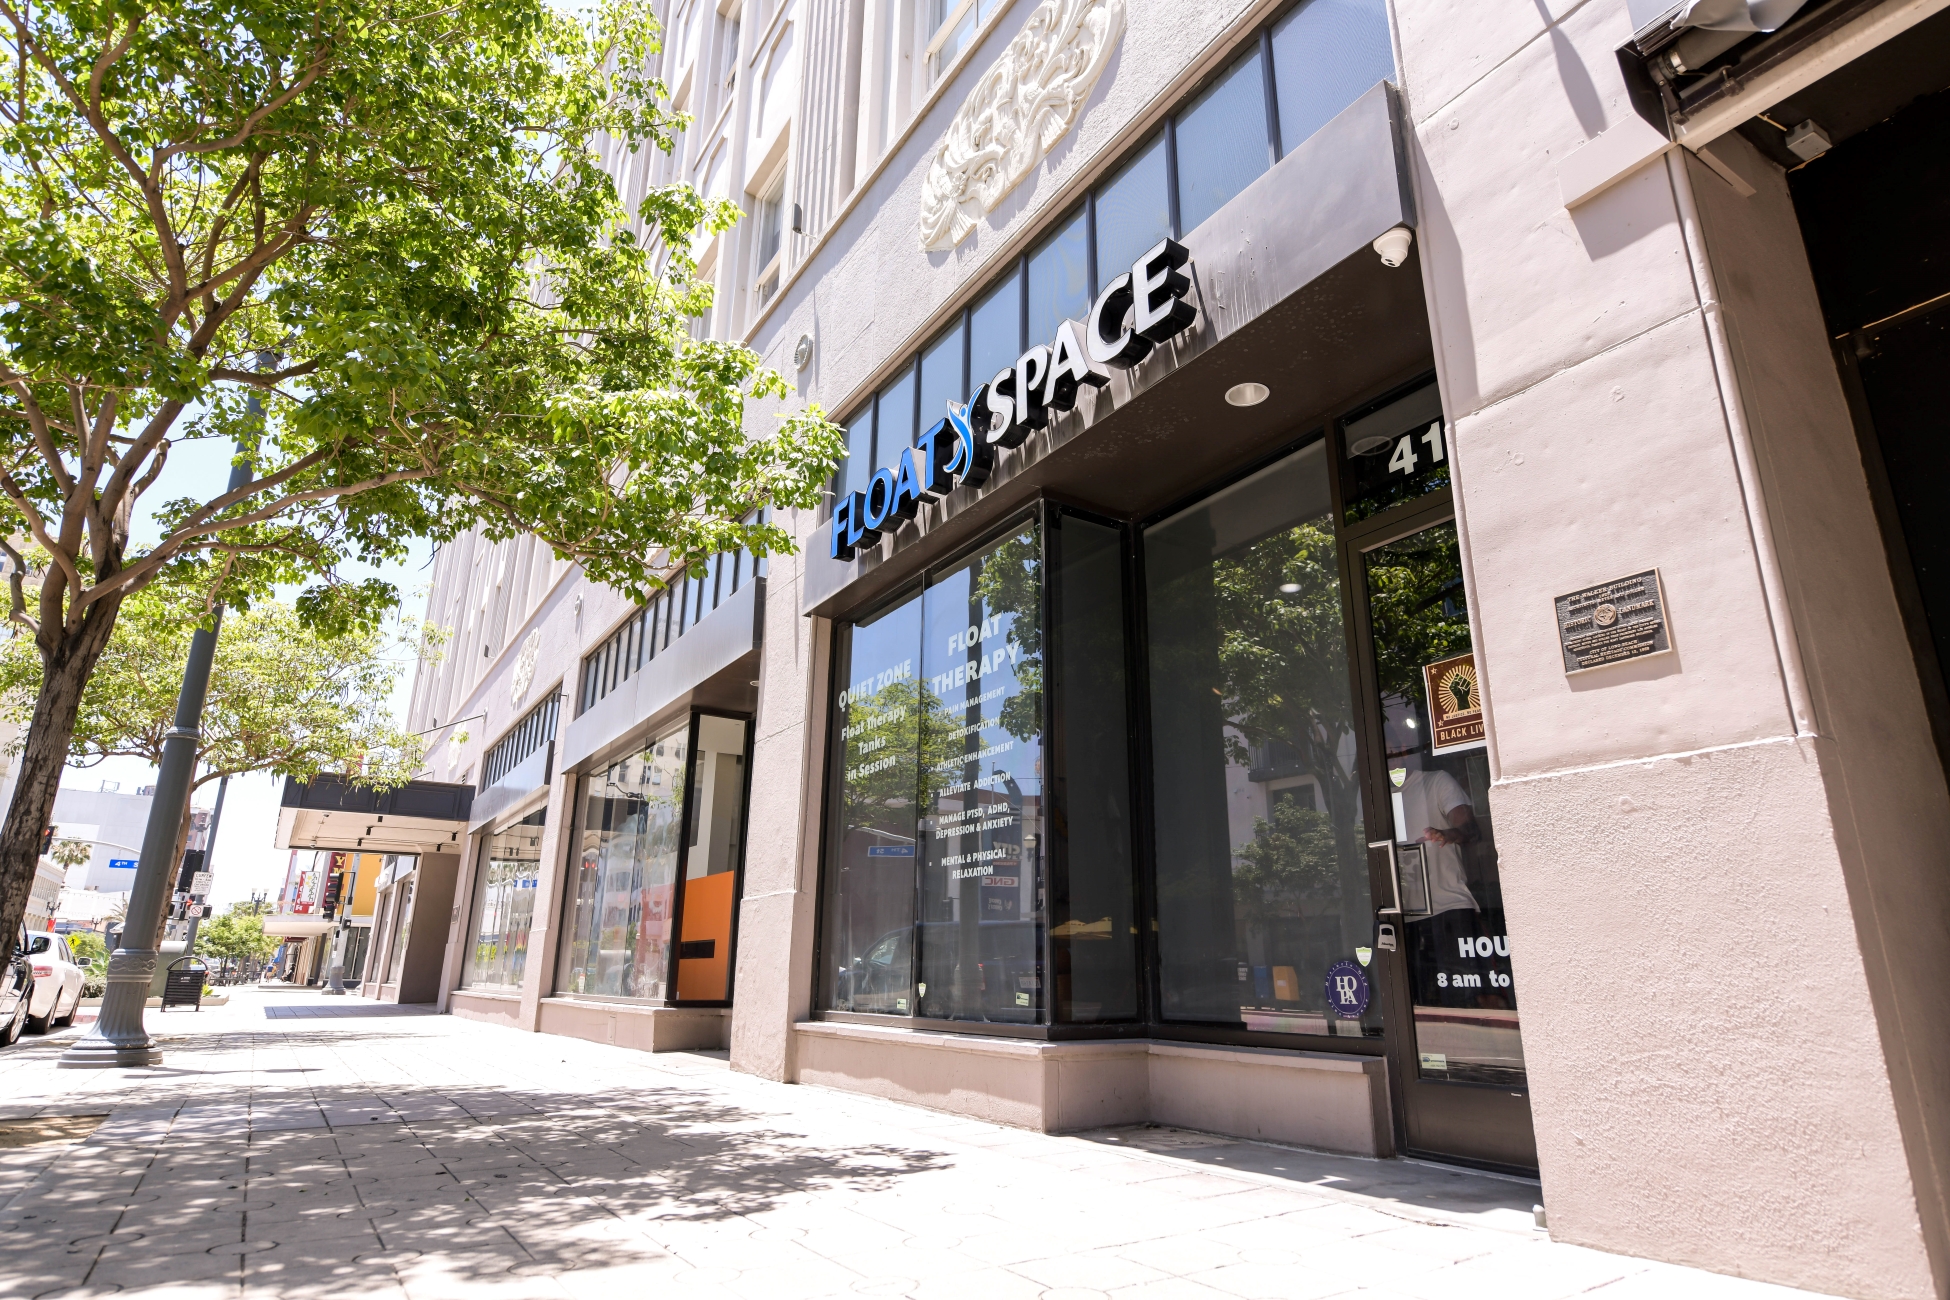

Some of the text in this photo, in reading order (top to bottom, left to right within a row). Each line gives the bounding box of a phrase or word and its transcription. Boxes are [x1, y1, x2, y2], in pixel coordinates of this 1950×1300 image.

[831, 237, 1192, 561] FLOAT SPACE
[1388, 421, 1444, 476] 41
[1609, 577, 1642, 589] BUILDING
[1619, 599, 1655, 613] LANDMARK
[948, 613, 1002, 656] FLOAT
[1563, 616, 1592, 629] HISTORIC
[932, 640, 1020, 696] THERAPY
[839, 658, 911, 712] QUIET ZONE
[944, 686, 1005, 716] PAIN MANAGEMENT
[841, 704, 906, 742] Float Therapy
[948, 716, 1001, 742] DETOXIFICATION
[1440, 723, 1485, 741] BLACK LIV
[858, 735, 886, 756] Tanks
[937, 740, 1014, 772] ATHLETIC ENHANCEMENT
[859, 754, 896, 778] Session
[939, 772, 1011, 798] ALLEVIATE ADDICTION
[939, 802, 1010, 825] MANAGE PTSD, ADHD,
[936, 816, 1013, 840] DEPRESSION & ANXIETY
[941, 853, 965, 867] MENTAL
[966, 854, 972, 863] &
[973, 848, 1006, 863] PHYSICAL
[952, 865, 993, 880] RELAXATION
[1458, 935, 1510, 958] HOU
[1436, 970, 1510, 988] 8 am to
